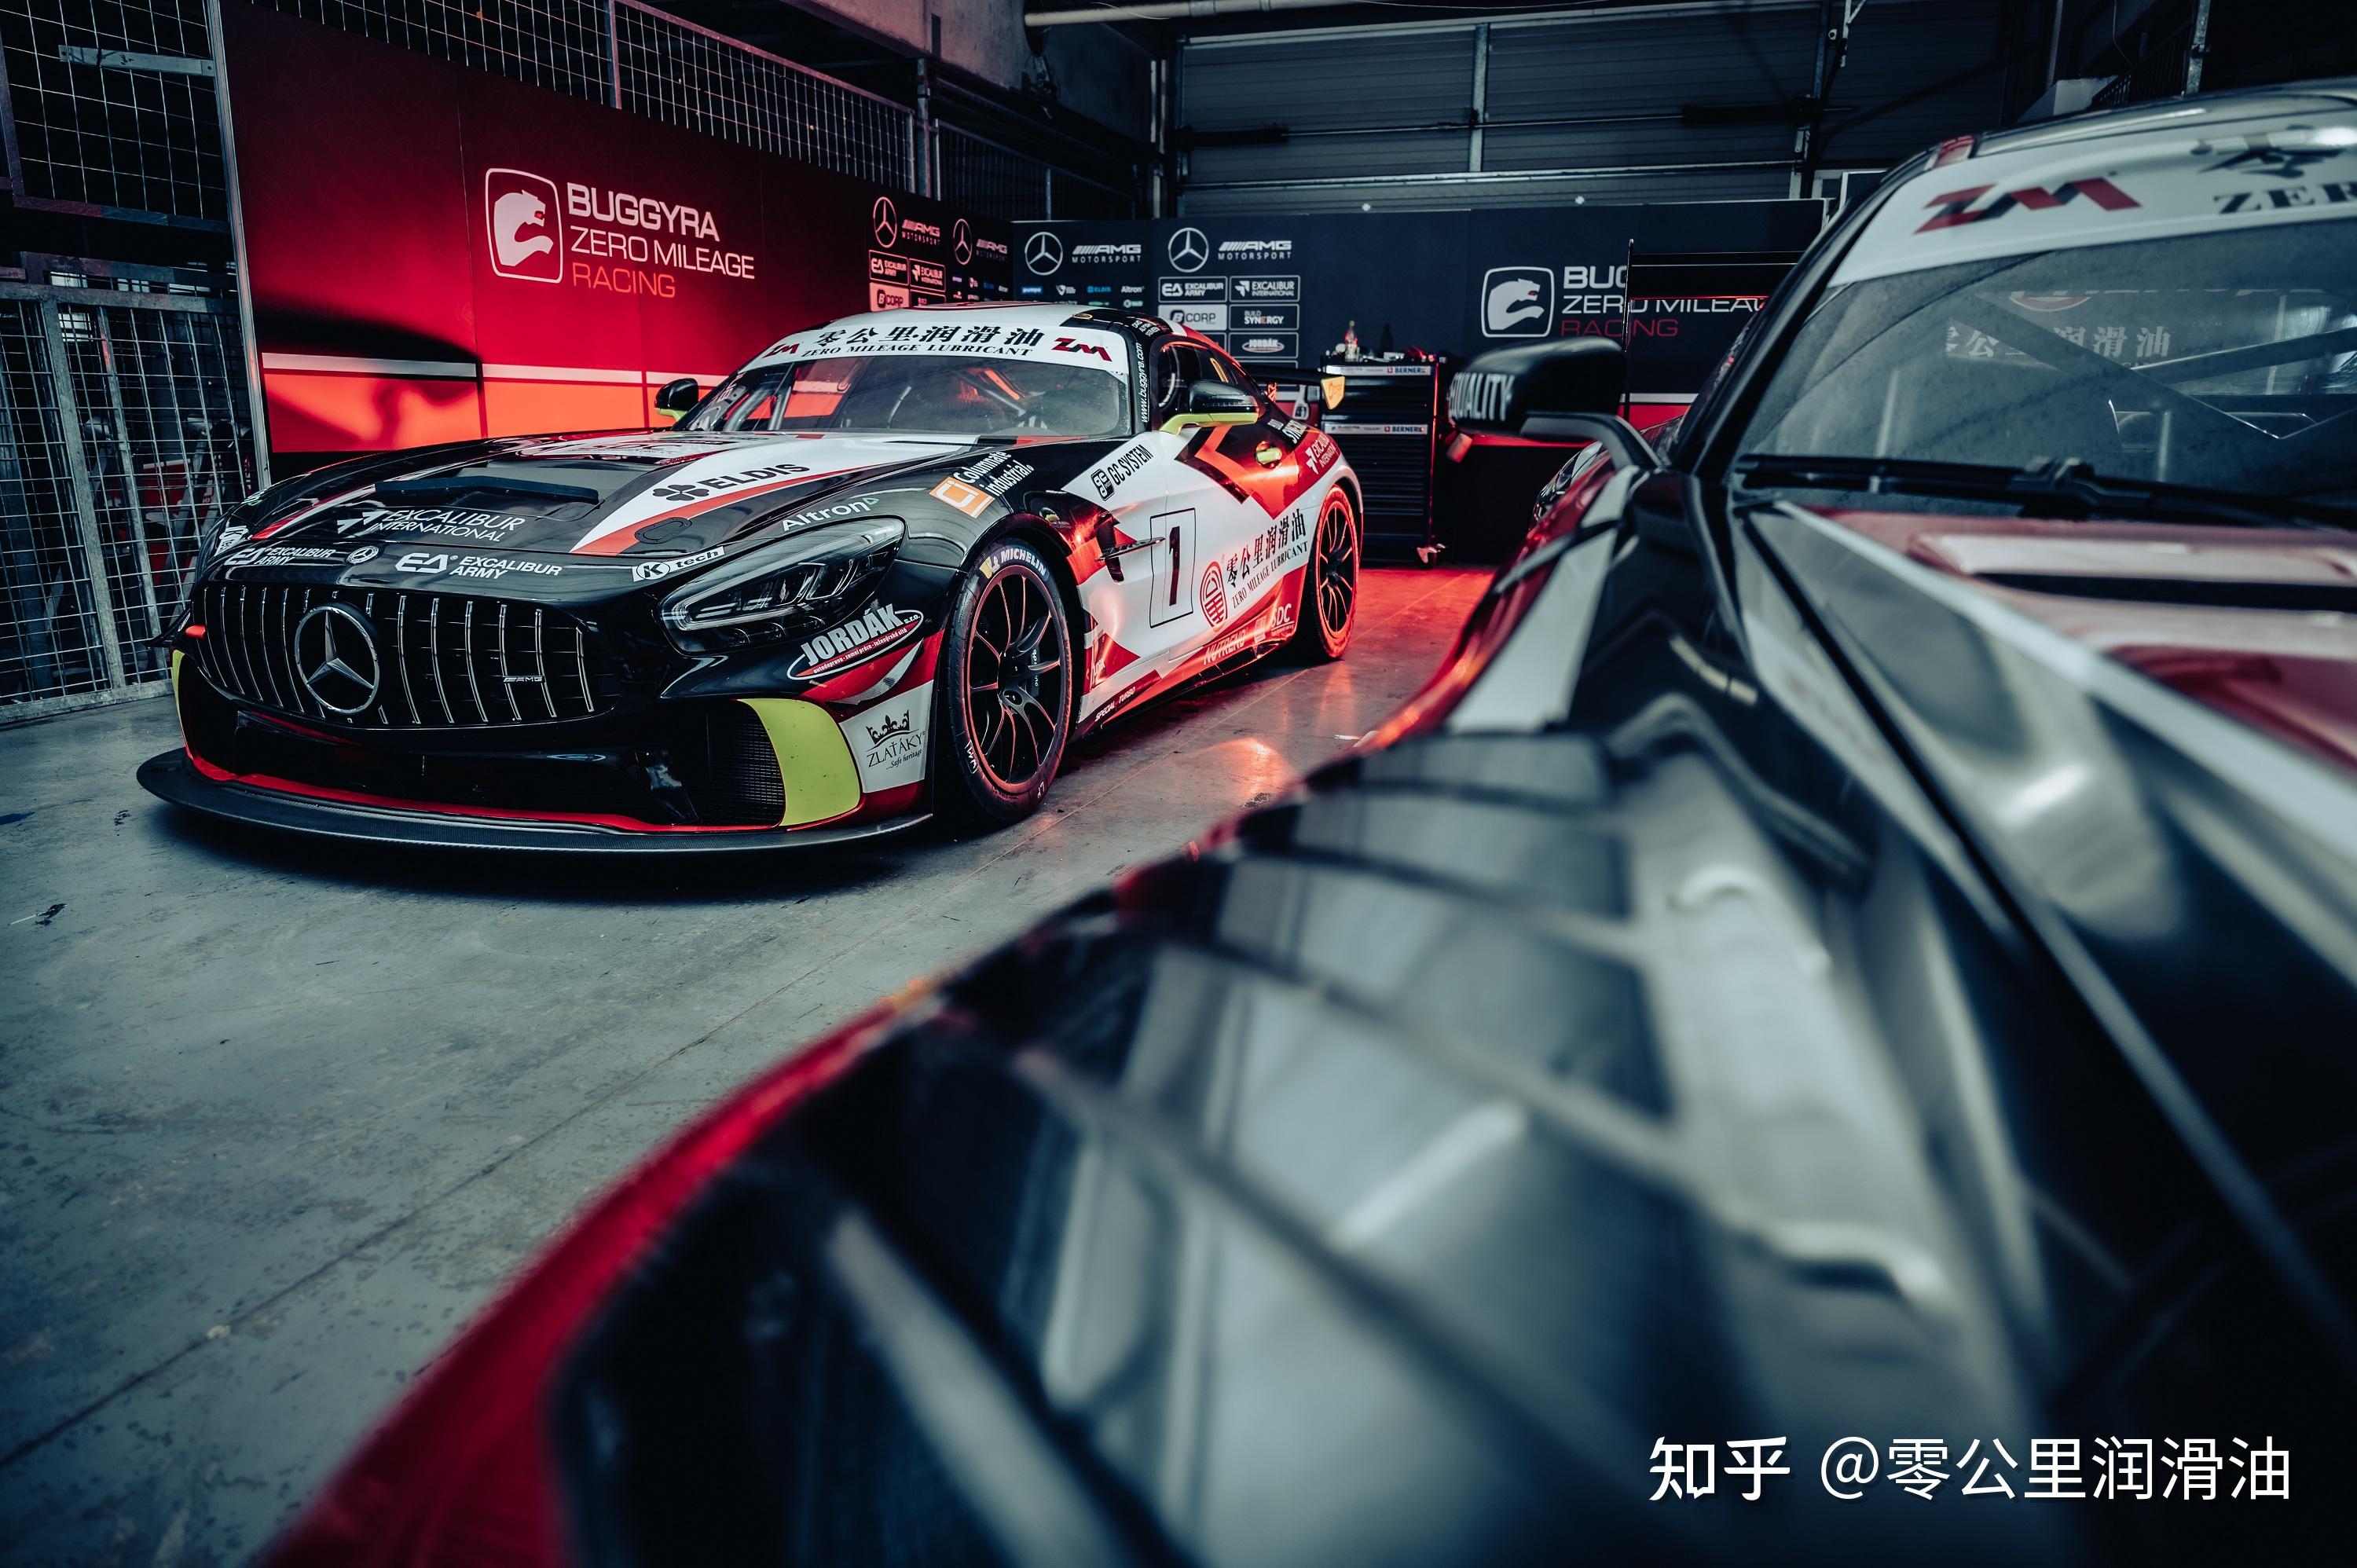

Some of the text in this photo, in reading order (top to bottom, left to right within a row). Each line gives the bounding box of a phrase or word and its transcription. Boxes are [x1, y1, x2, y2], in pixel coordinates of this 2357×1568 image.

[567, 182, 720, 242] BUGGYRA
[902, 231, 940, 246] MOTORSPORT
[570, 225, 755, 280] ZERO MILEAGE
[572, 262, 676, 298] RACING
[1252, 281, 1295, 291] EXCALIBUR
[1186, 313, 1216, 323] CORP
[1244, 315, 1285, 324] SYNERGY
[1560, 319, 1678, 337] RACNG
[812, 325, 1046, 346] 零公里润滑油
[801, 344, 1034, 357] ZERO MILEAGE LUBRICANT
[1135, 343, 1149, 423] www.buggyra.com
[953, 451, 1012, 484] Columnate
[1107, 444, 1154, 485] GC SYSTEM
[698, 463, 811, 490] ELDIS
[382, 509, 526, 531] EXCALIBUR
[782, 496, 874, 532] Altron
[365, 521, 506, 542] INTERNATIONAL
[267, 547, 337, 558] EXCALIBUR
[1226, 507, 1307, 588] 零公里润滑油
[253, 555, 296, 566] ARMY
[459, 556, 563, 577] EXCALIBUR
[675, 549, 720, 569] tech
[1000, 548, 1048, 577] MICHELIN
[1169, 526, 1180, 607] 1
[449, 566, 509, 579] ARMY
[1232, 540, 1308, 609] ZERO MILEAGE LUBRICANT
[904, 614, 921, 625] s.r.o.
[801, 603, 904, 667] JORDÁK
[1095, 701, 1116, 722] SPECIAL
[867, 735, 922, 768] ZLAŤÁKY
[904, 747, 922, 764] heritage
